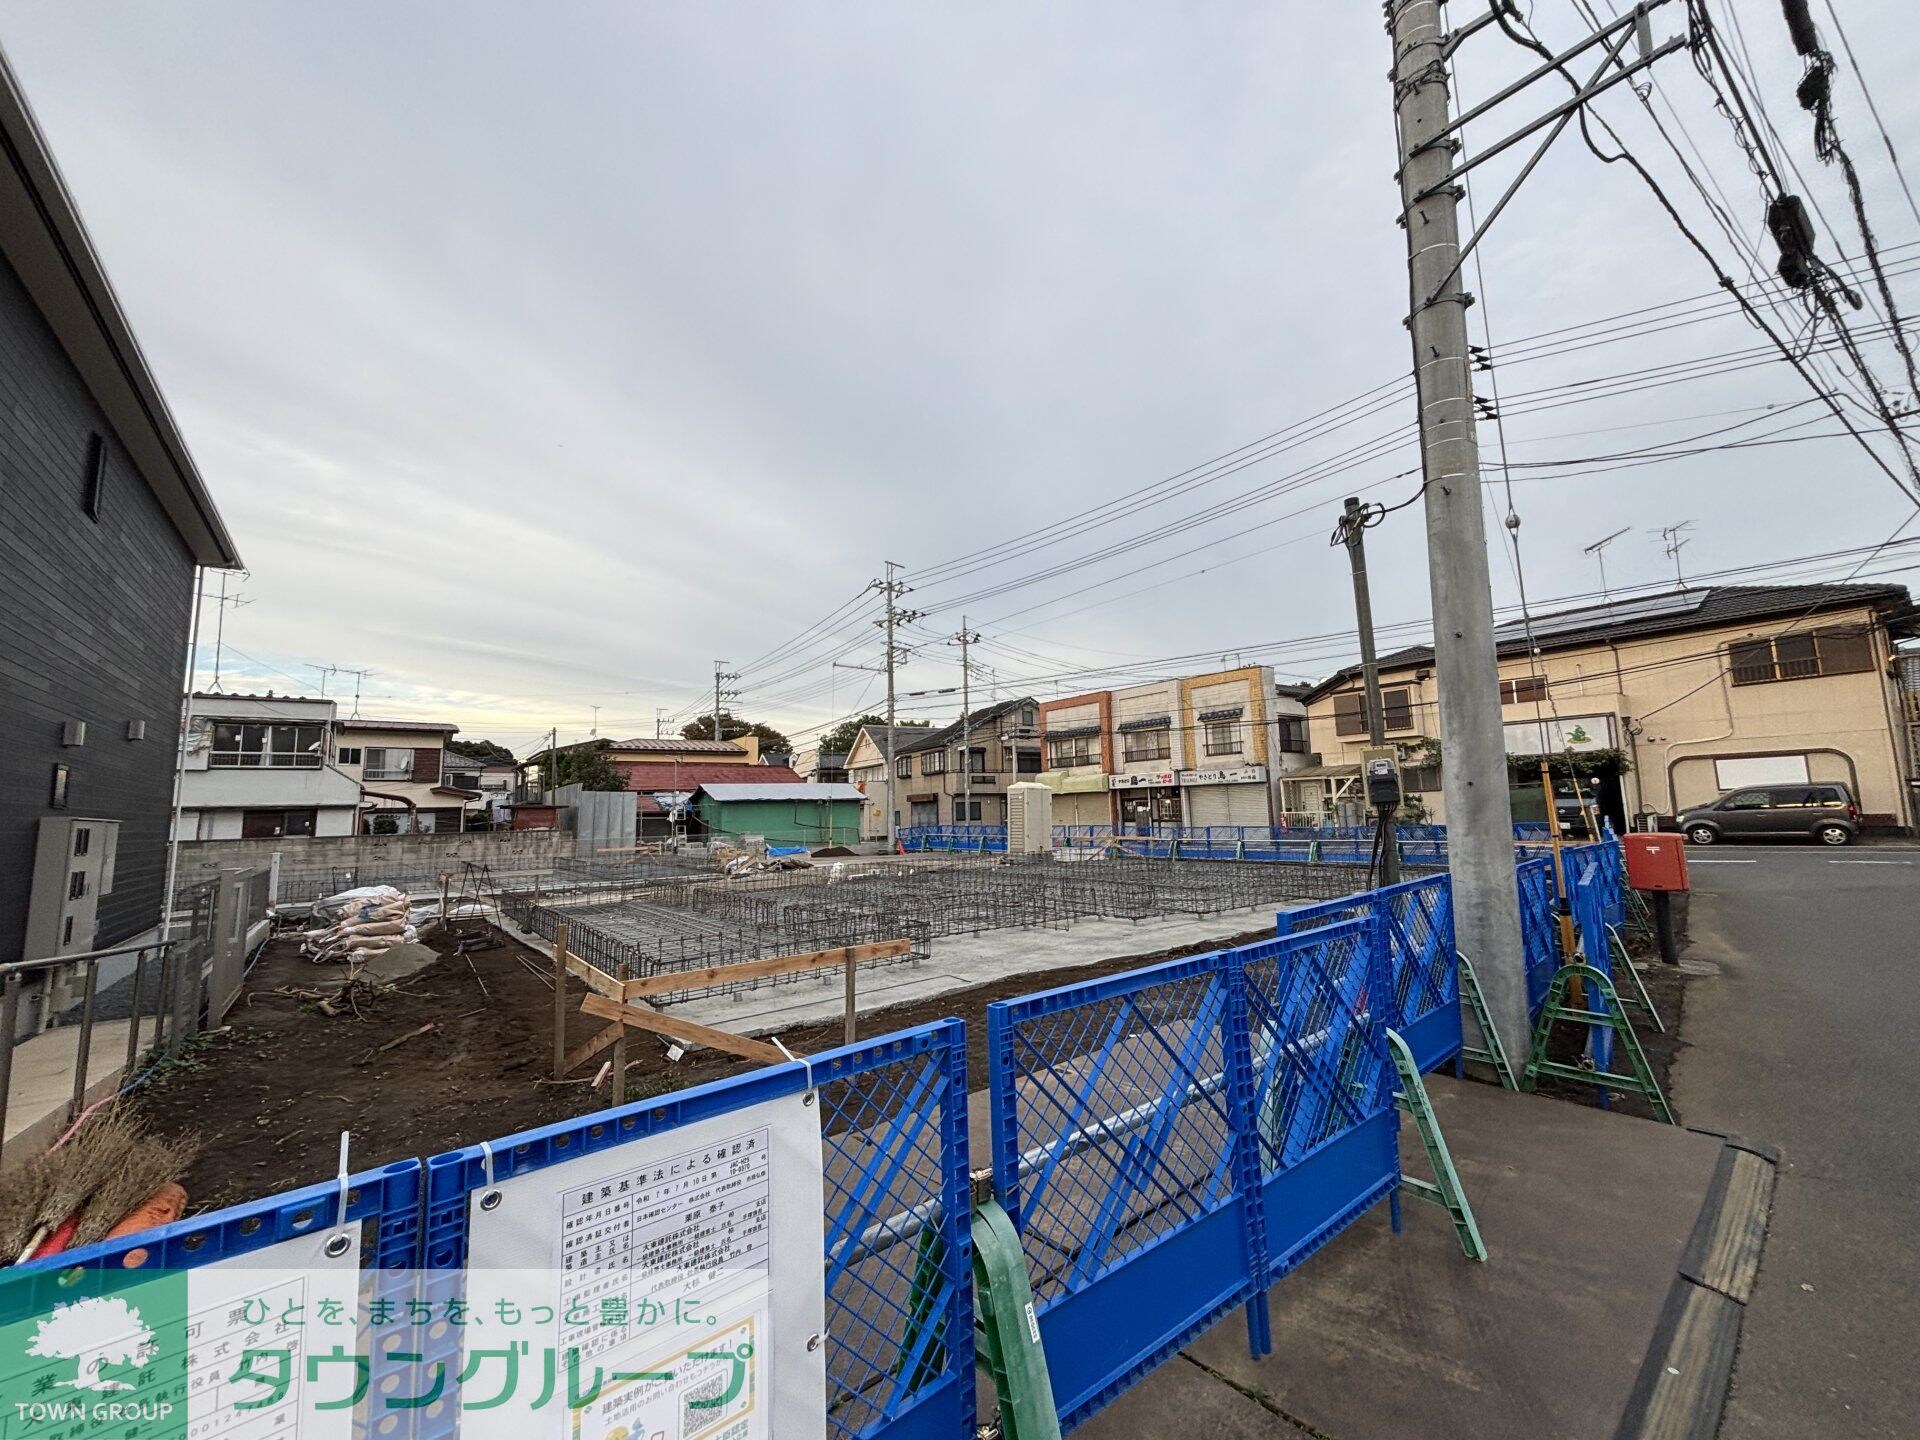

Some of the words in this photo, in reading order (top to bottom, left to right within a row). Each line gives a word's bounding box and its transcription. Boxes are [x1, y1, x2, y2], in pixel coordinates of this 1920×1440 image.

[581, 1139, 756, 1206] 建築基準法による確認済
[565, 1201, 629, 1230] 確認年月日番号
[565, 1219, 629, 1249] 確認済証交付者
[636, 1201, 684, 1224] 日本確認センター
[688, 1190, 710, 1204] 株式会社
[642, 1223, 700, 1254] 大東建託株式会社
[641, 1239, 700, 1270] 大東建託株式会社
[676, 1244, 730, 1272] 大東建託株式会社
